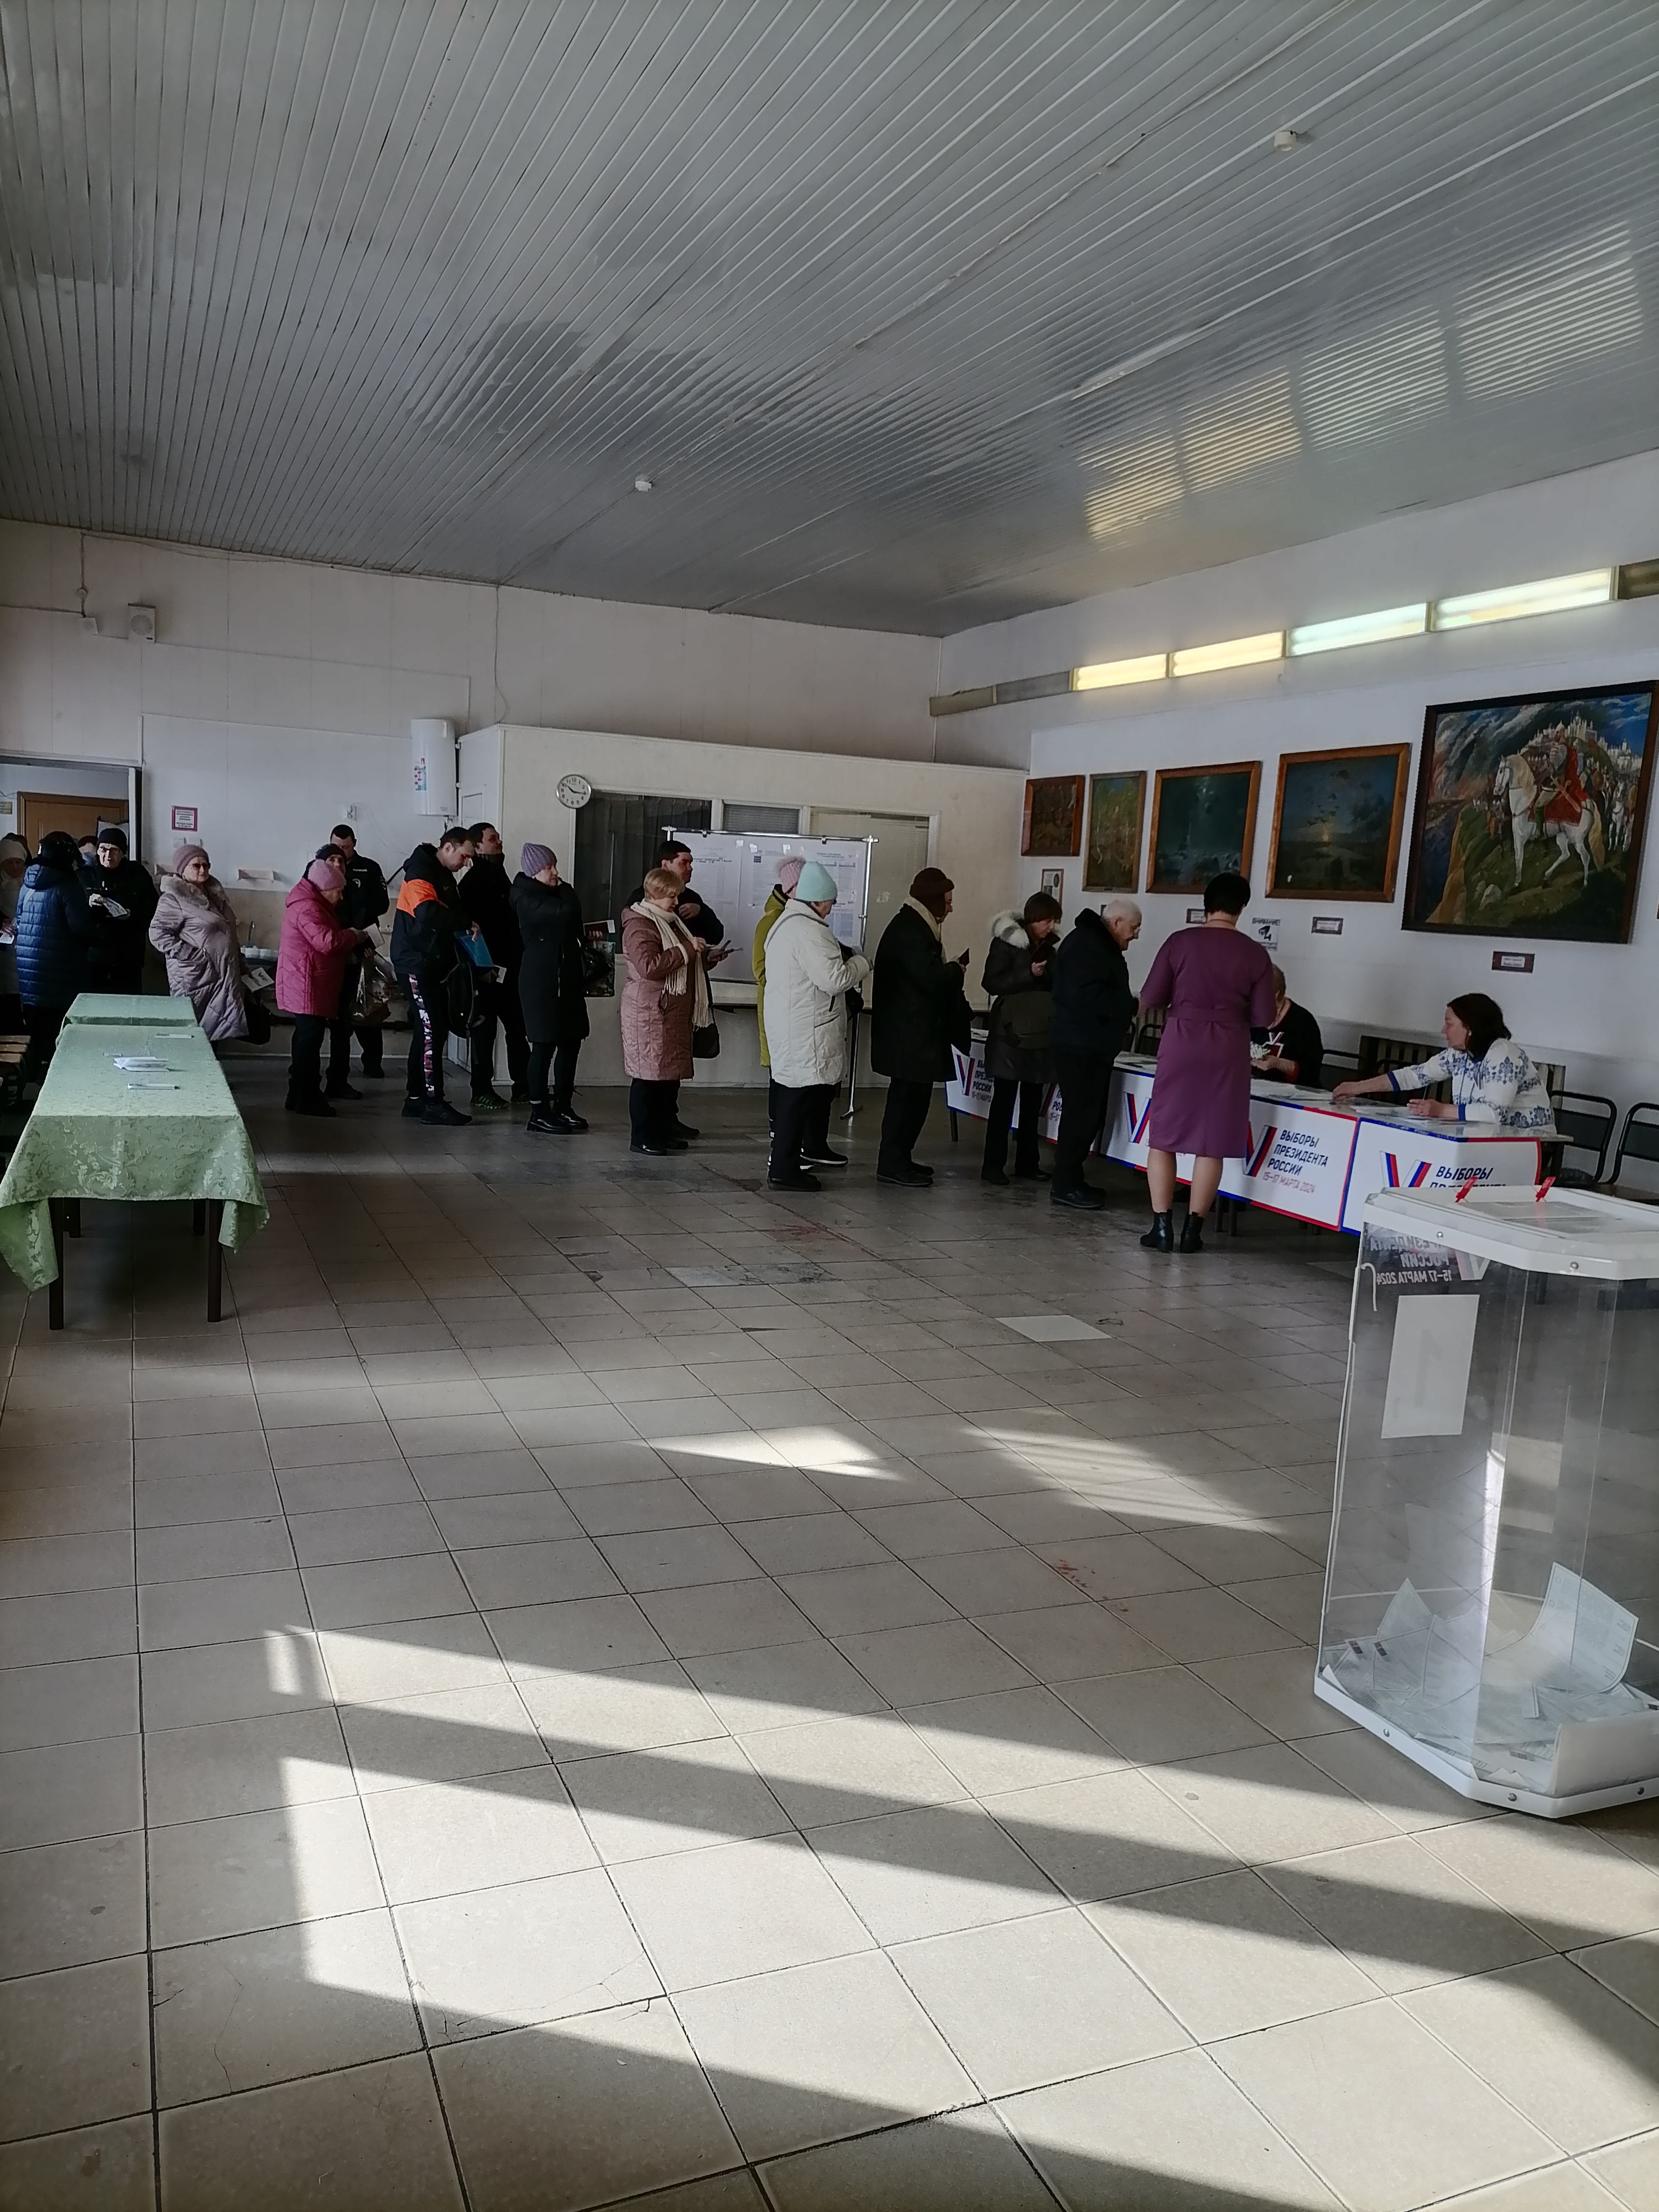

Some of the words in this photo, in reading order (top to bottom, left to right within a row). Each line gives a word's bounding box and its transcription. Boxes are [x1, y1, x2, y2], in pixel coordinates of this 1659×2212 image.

[1052, 1101, 1062, 1112] РОС
[1280, 1129, 1319, 1148] ВЫБОРЫ
[1273, 1144, 1328, 1167] ПРЕЗИДЕНТА
[1267, 1158, 1303, 1176] РОССИИ
[1436, 1166, 1494, 1181] ВЫБОРЫ
[1280, 1176, 1301, 1189] МАРТА
[1300, 1181, 1316, 1194] 2024
